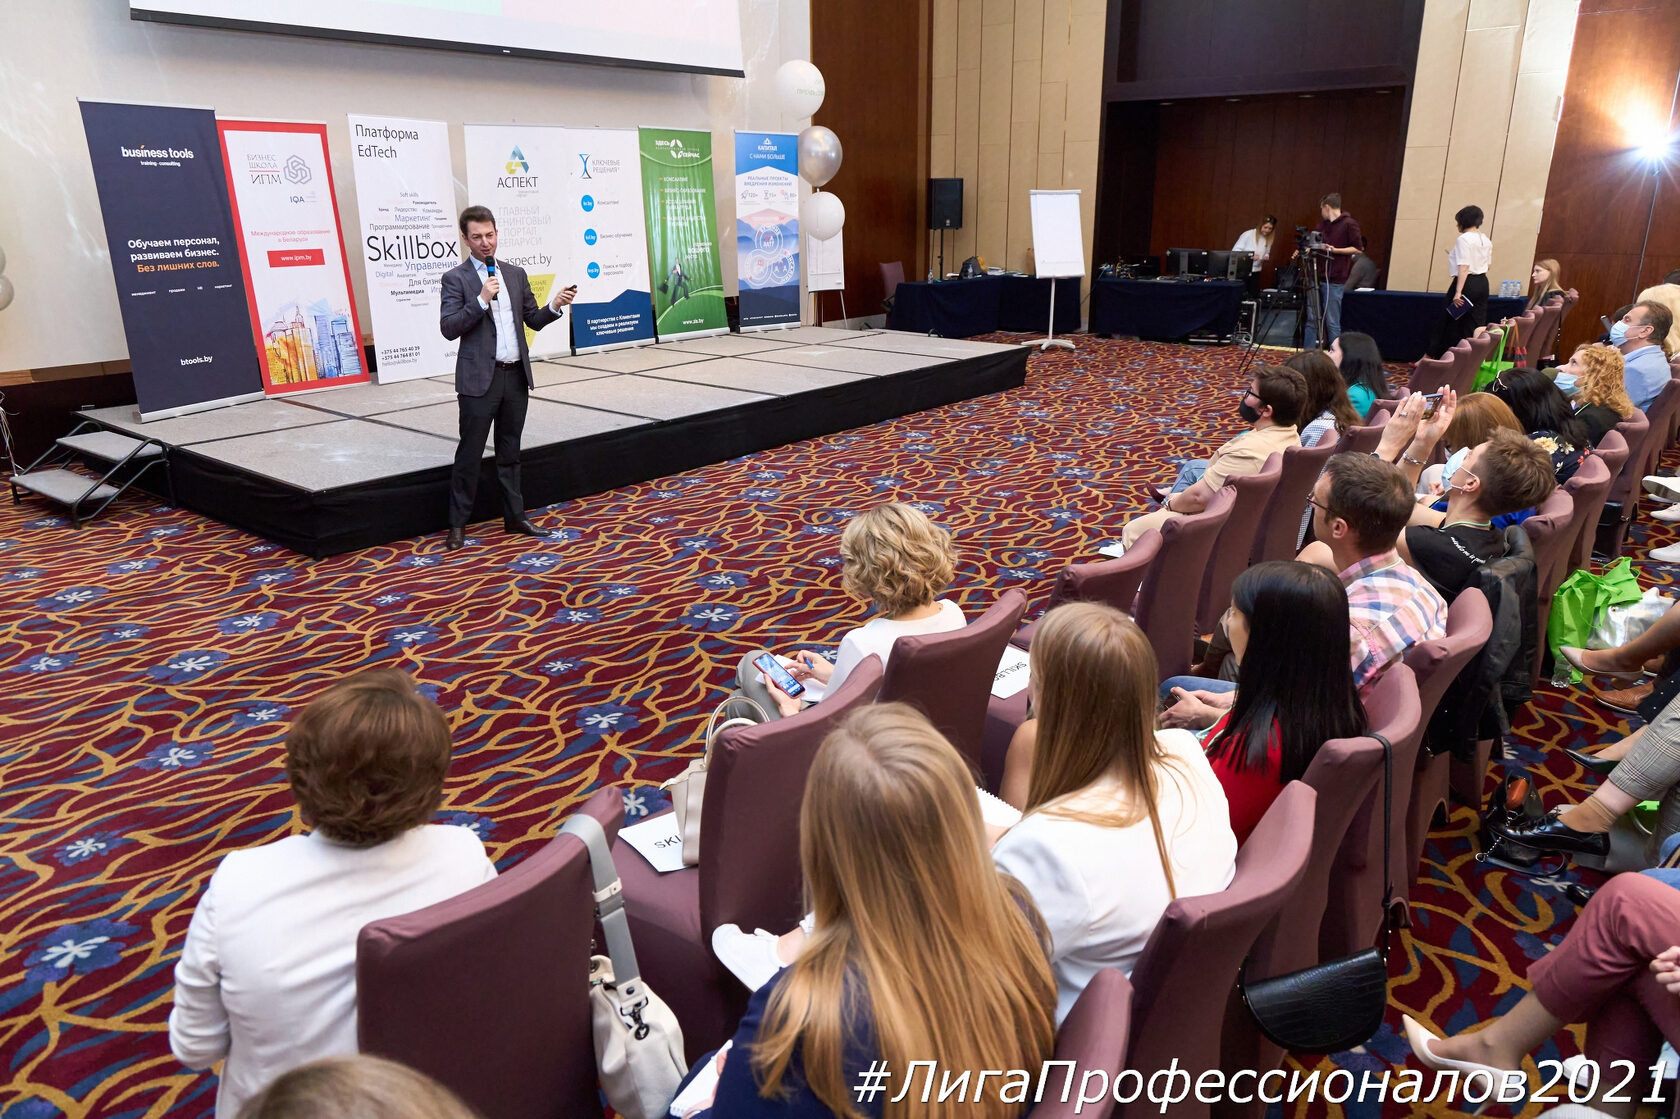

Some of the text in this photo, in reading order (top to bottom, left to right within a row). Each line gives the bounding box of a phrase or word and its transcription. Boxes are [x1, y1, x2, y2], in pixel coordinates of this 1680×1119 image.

[356, 124, 418, 142] Платформа
[121, 144, 194, 159] business tools
[358, 144, 397, 158] EdTech
[250, 174, 282, 184] ИПМ
[497, 176, 538, 188] АСПЕКТ
[290, 196, 304, 204] IQA
[499, 206, 540, 216] ГЛАВНЫЙ
[395, 214, 431, 223] Маркетинг
[498, 214, 552, 227] ЕНИНГОВЫЙ
[504, 227, 537, 237] ПОРТАЛ
[128, 237, 220, 250] Обучаем персонал,
[367, 235, 458, 261] Skillbox
[499, 236, 542, 248] БЕЛАРУСИ
[130, 248, 220, 262] развиваем бизнес.
[137, 260, 220, 272] Без лишних слов.
[405, 260, 458, 273] Управление
[409, 279, 421, 287] Для
[180, 356, 212, 365] btools.by
[654, 835, 682, 848] SKI
